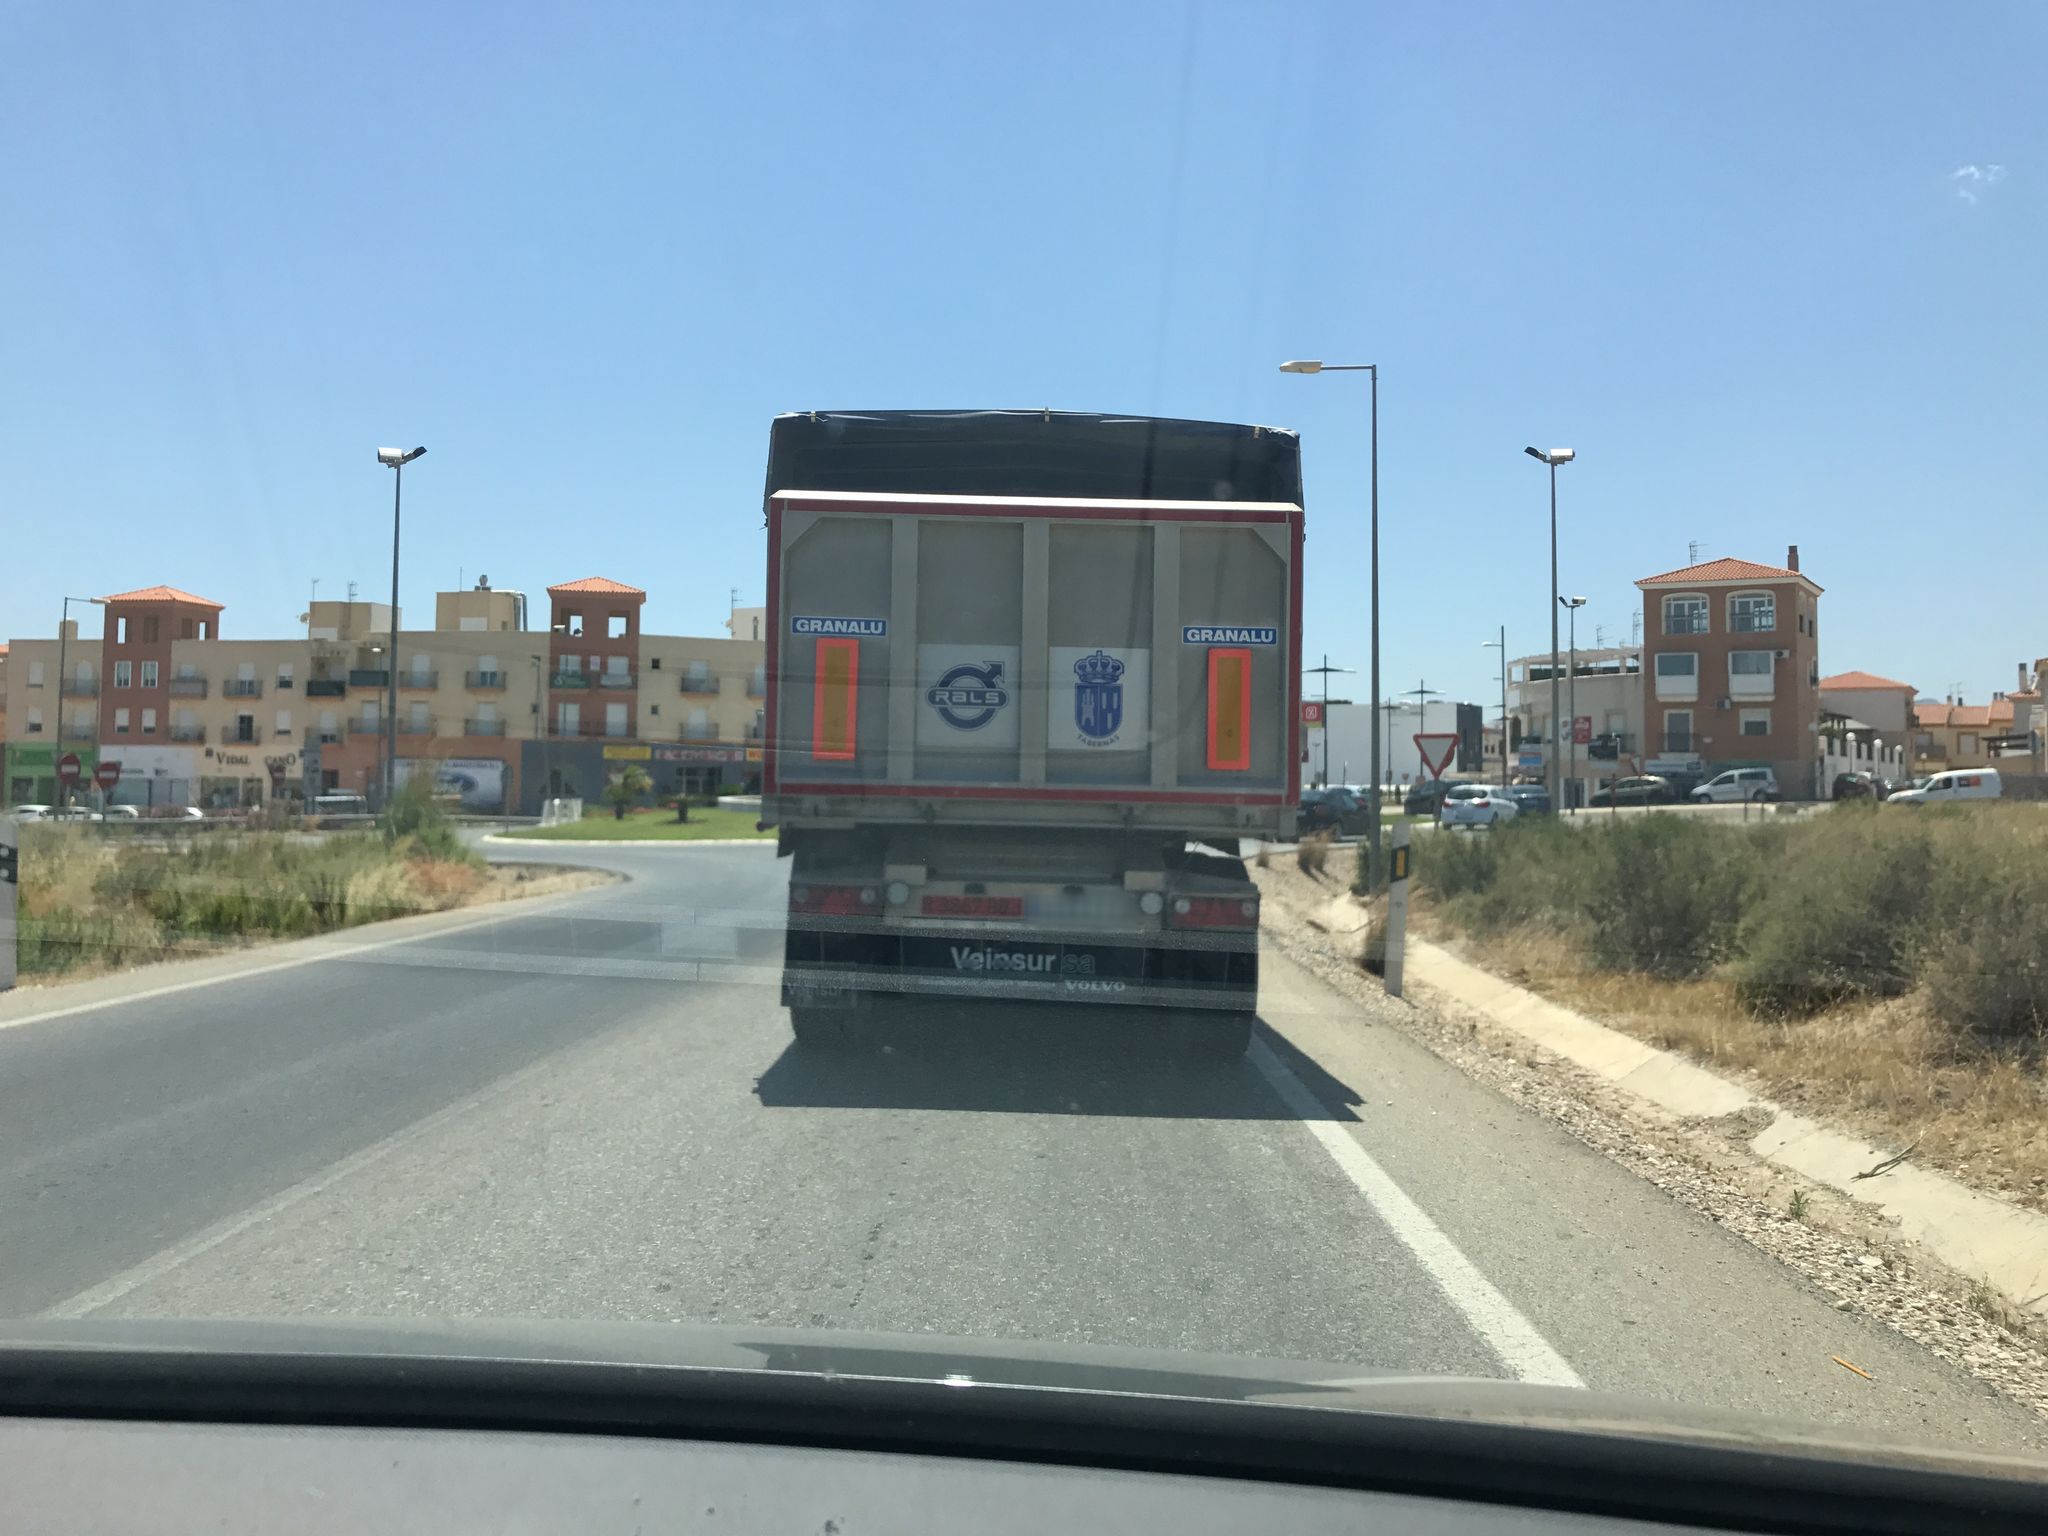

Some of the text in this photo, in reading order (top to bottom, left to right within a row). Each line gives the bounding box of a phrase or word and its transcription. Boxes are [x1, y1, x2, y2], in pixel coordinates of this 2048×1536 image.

[796, 619, 883, 634] GRANALU
[1186, 628, 1274, 643] GRANALU
[1065, 980, 1127, 992] VOLVO
